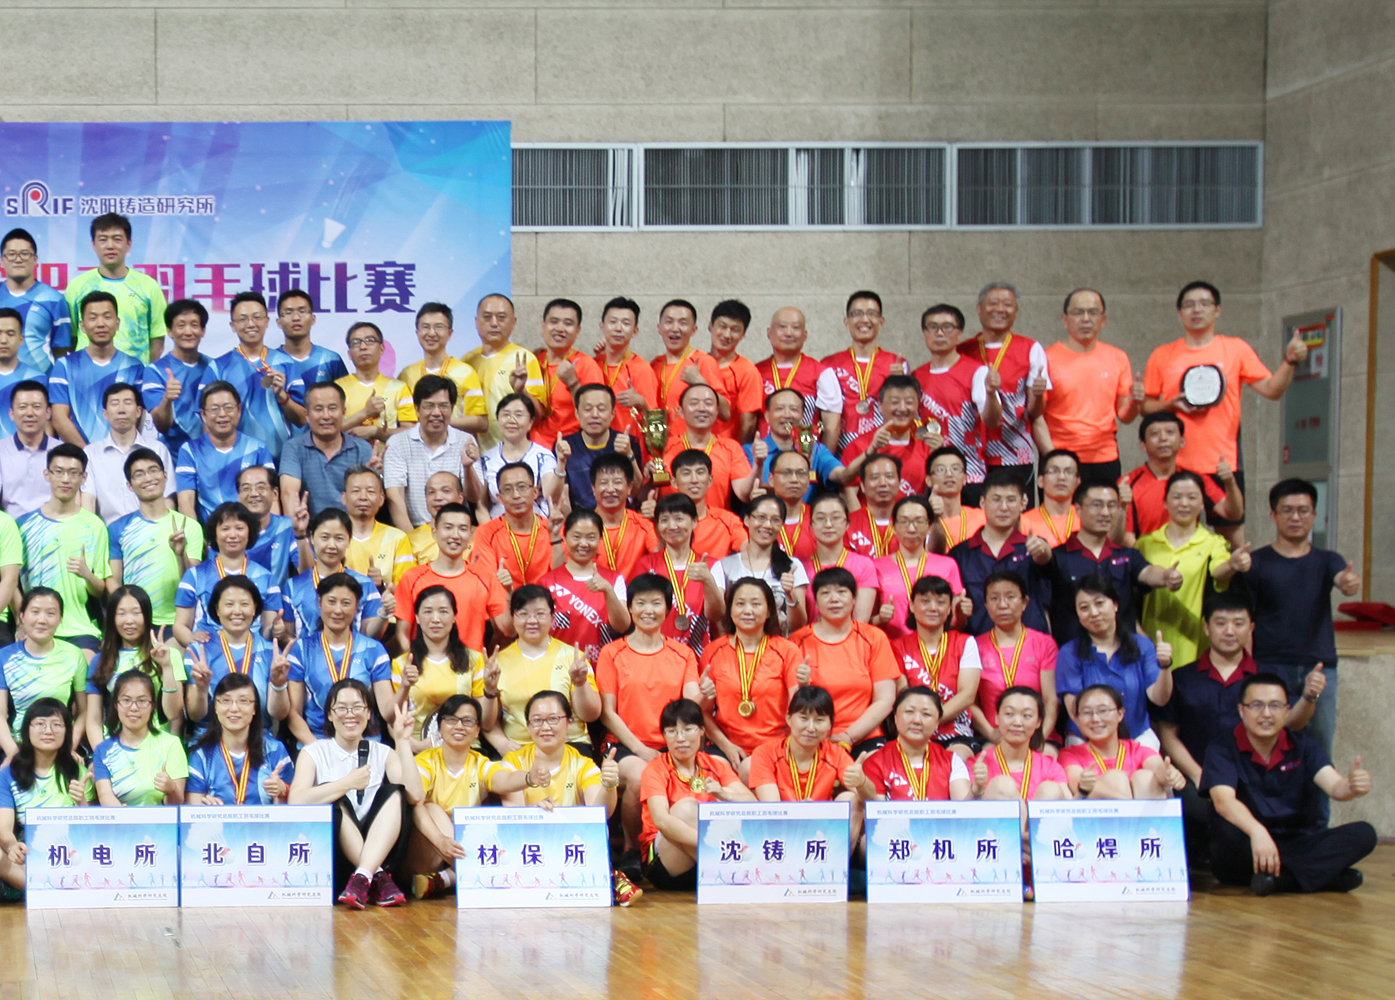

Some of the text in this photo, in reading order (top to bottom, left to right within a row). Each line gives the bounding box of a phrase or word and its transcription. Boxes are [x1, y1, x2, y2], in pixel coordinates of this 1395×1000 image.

[80, 196, 214, 214] 沈阳铸造研究所
[568, 594, 603, 628] YONEX
[917, 668, 954, 701] YOEX
[48, 844, 156, 866] 机电所
[202, 842, 310, 864] 北自所
[477, 844, 585, 865] 材保所
[720, 840, 827, 861] 沈铸所
[888, 839, 998, 860] 郑机所
[1053, 838, 1161, 859] 哈焊所
